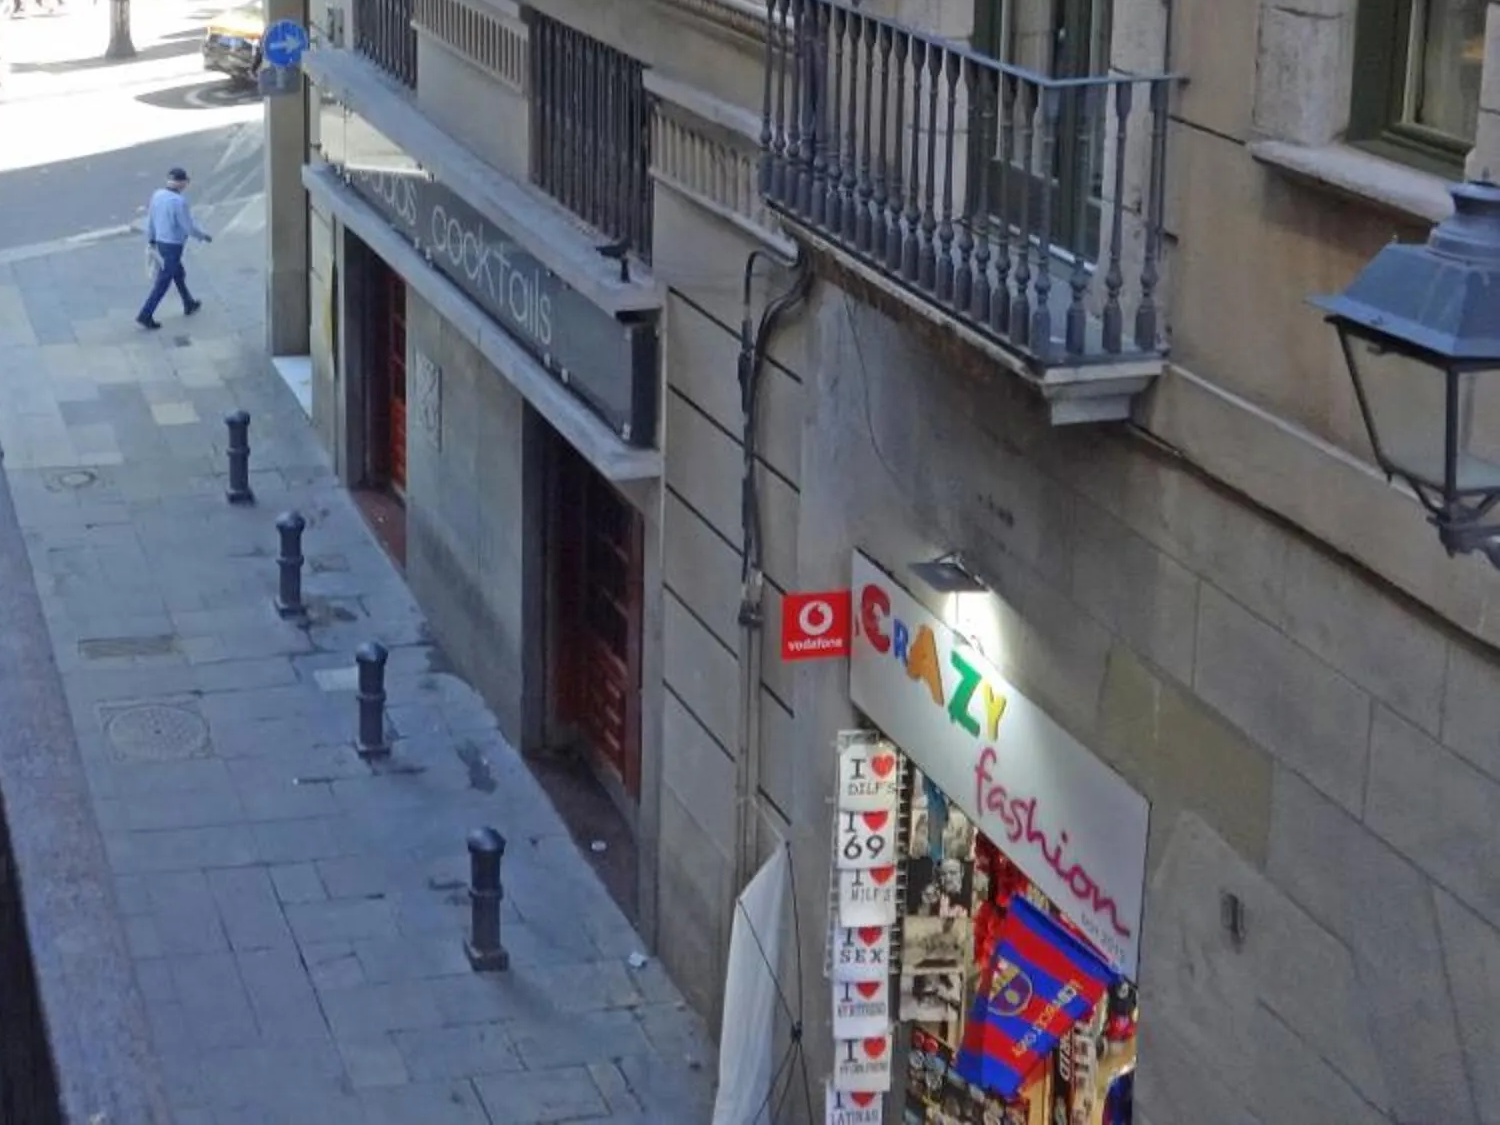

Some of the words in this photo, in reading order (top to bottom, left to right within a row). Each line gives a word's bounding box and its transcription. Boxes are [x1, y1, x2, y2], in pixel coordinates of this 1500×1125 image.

[787, 637, 843, 652] vodafone
[861, 583, 1007, 742] CRAZY
[850, 758, 867, 780] I
[843, 834, 886, 860] 69
[974, 747, 1131, 938] fashion
[839, 948, 884, 964] SEX
